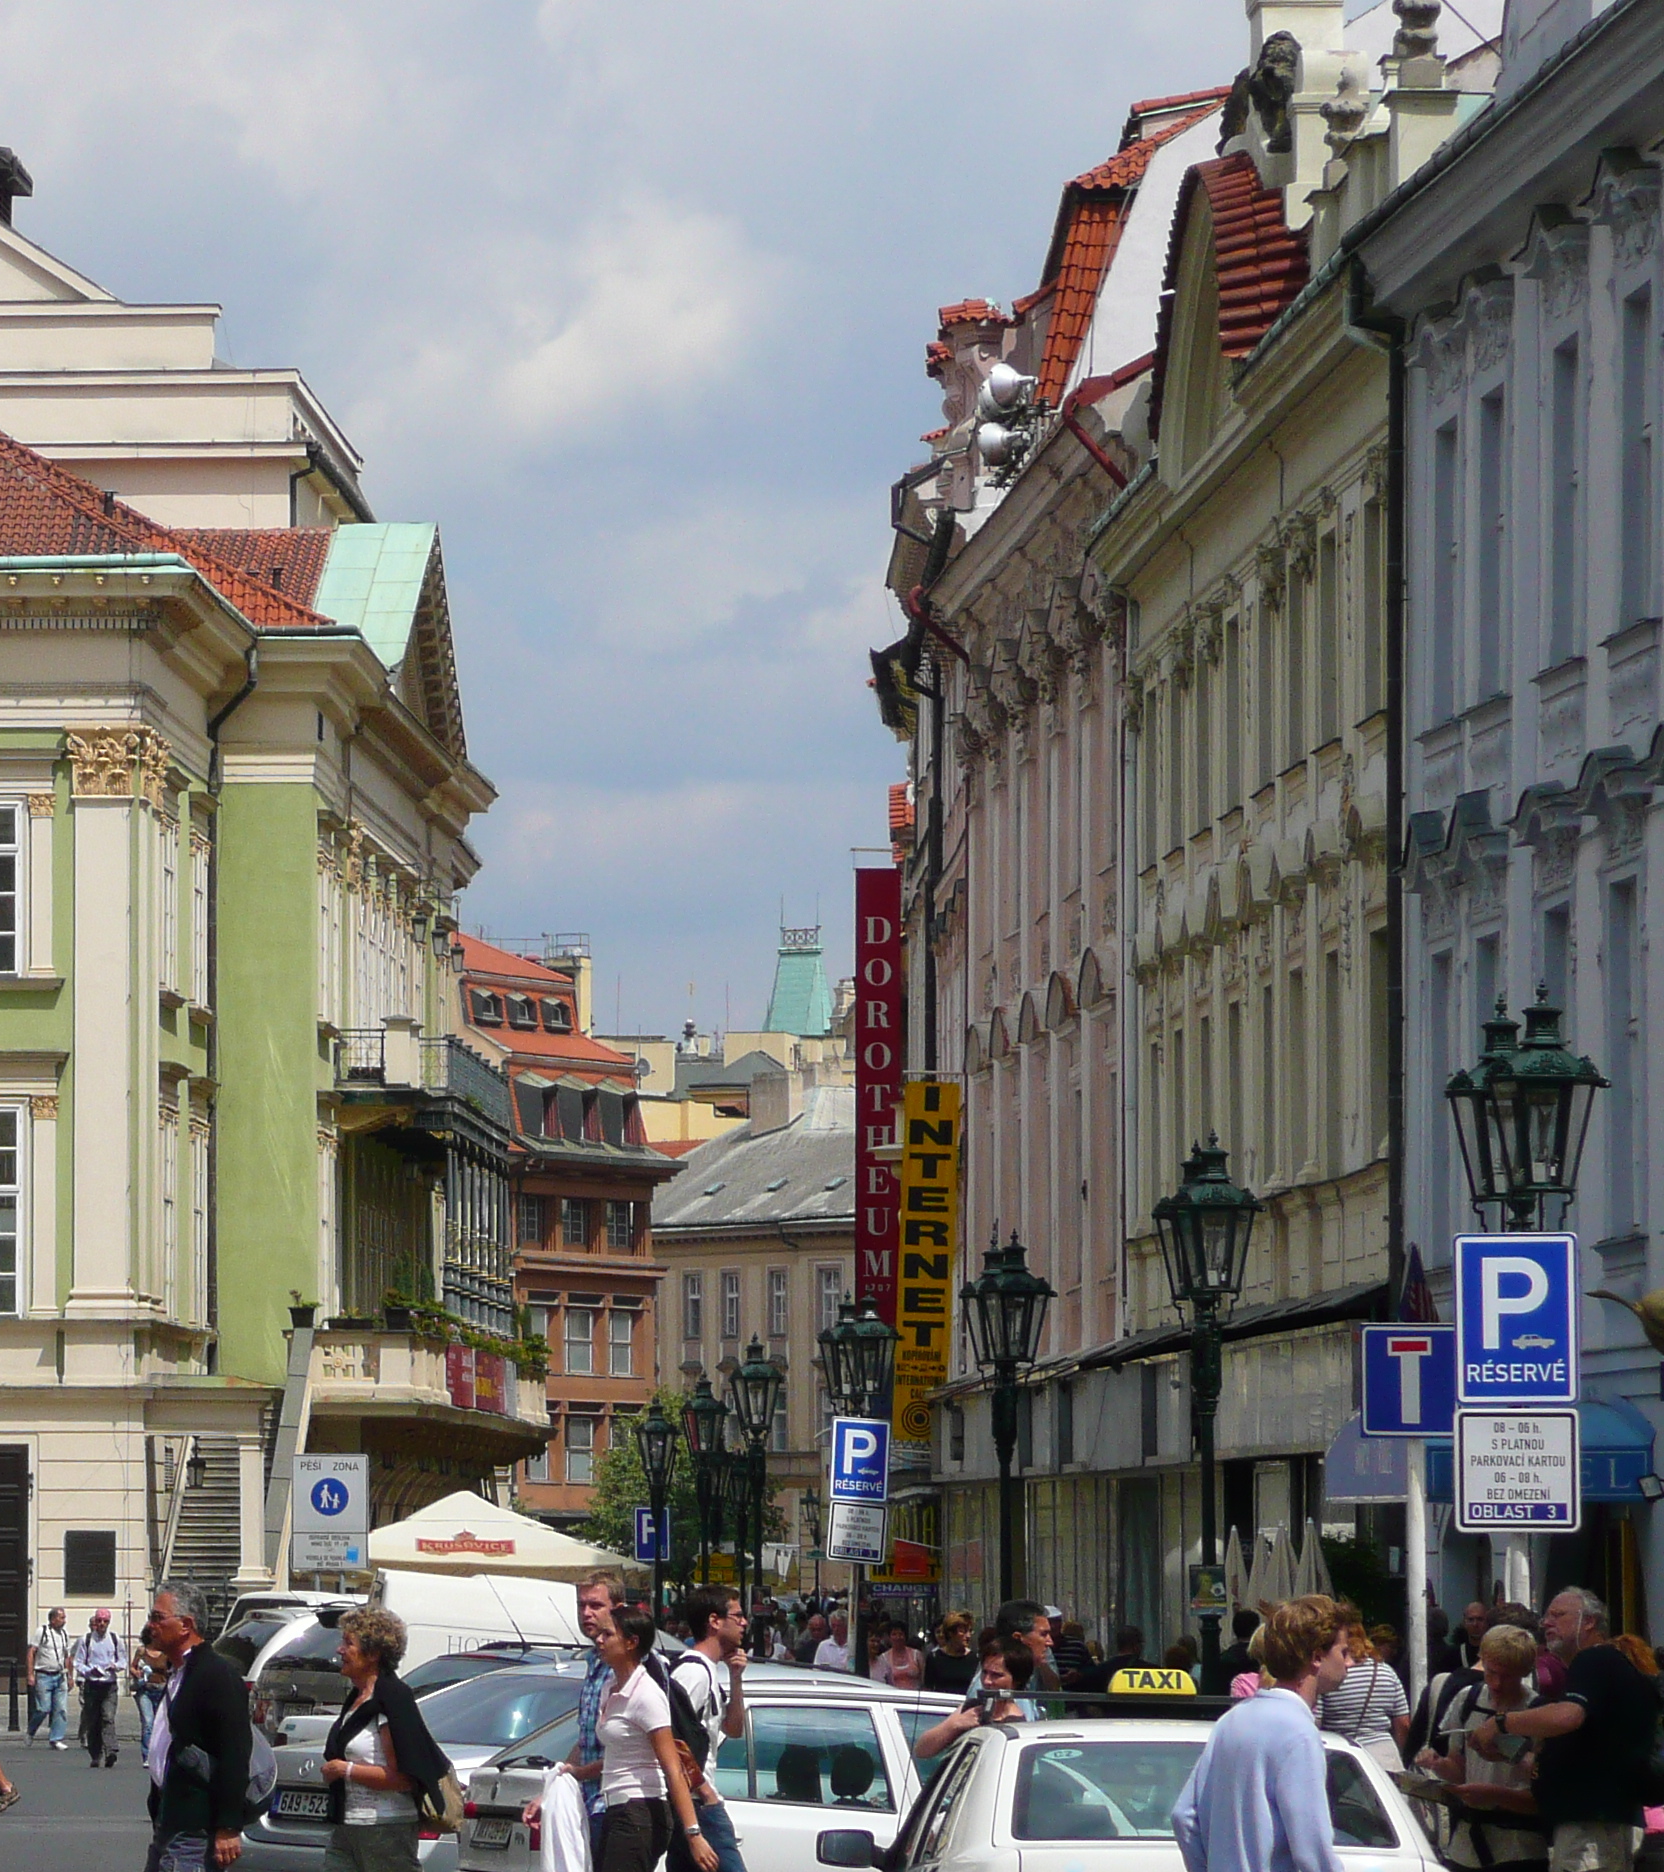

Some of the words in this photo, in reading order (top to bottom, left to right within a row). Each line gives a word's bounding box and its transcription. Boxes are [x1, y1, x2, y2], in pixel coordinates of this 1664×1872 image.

[864, 916, 892, 1277] DOROTHEUM
[903, 1086, 953, 1347] INTERNET
[1482, 1257, 1549, 1349] P
[1467, 1358, 1565, 1382] RÉSERVÉ
[1493, 1422, 1505, 1433] 08
[1518, 1422, 1530, 1433] 06
[1533, 1422, 1542, 1433] h.
[843, 1428, 877, 1474] P
[1491, 1439, 1498, 1449] S
[1501, 1439, 1544, 1450] PLATNOU
[1470, 1453, 1524, 1466] PARKOVACÍ
[1528, 1455, 1565, 1467] KARTOU
[835, 1478, 883, 1493] RÉSERVÉ
[1494, 1472, 1506, 1483] 06
[1518, 1472, 1530, 1483] 08
[1533, 1472, 1542, 1484] h.
[1487, 1488, 1505, 1500] BEZ
[1508, 1486, 1550, 1500] OMEZENÍ
[1472, 1504, 1534, 1519] OBLAST
[1547, 1504, 1556, 1519] 3
[1122, 1671, 1182, 1689] TAXI
